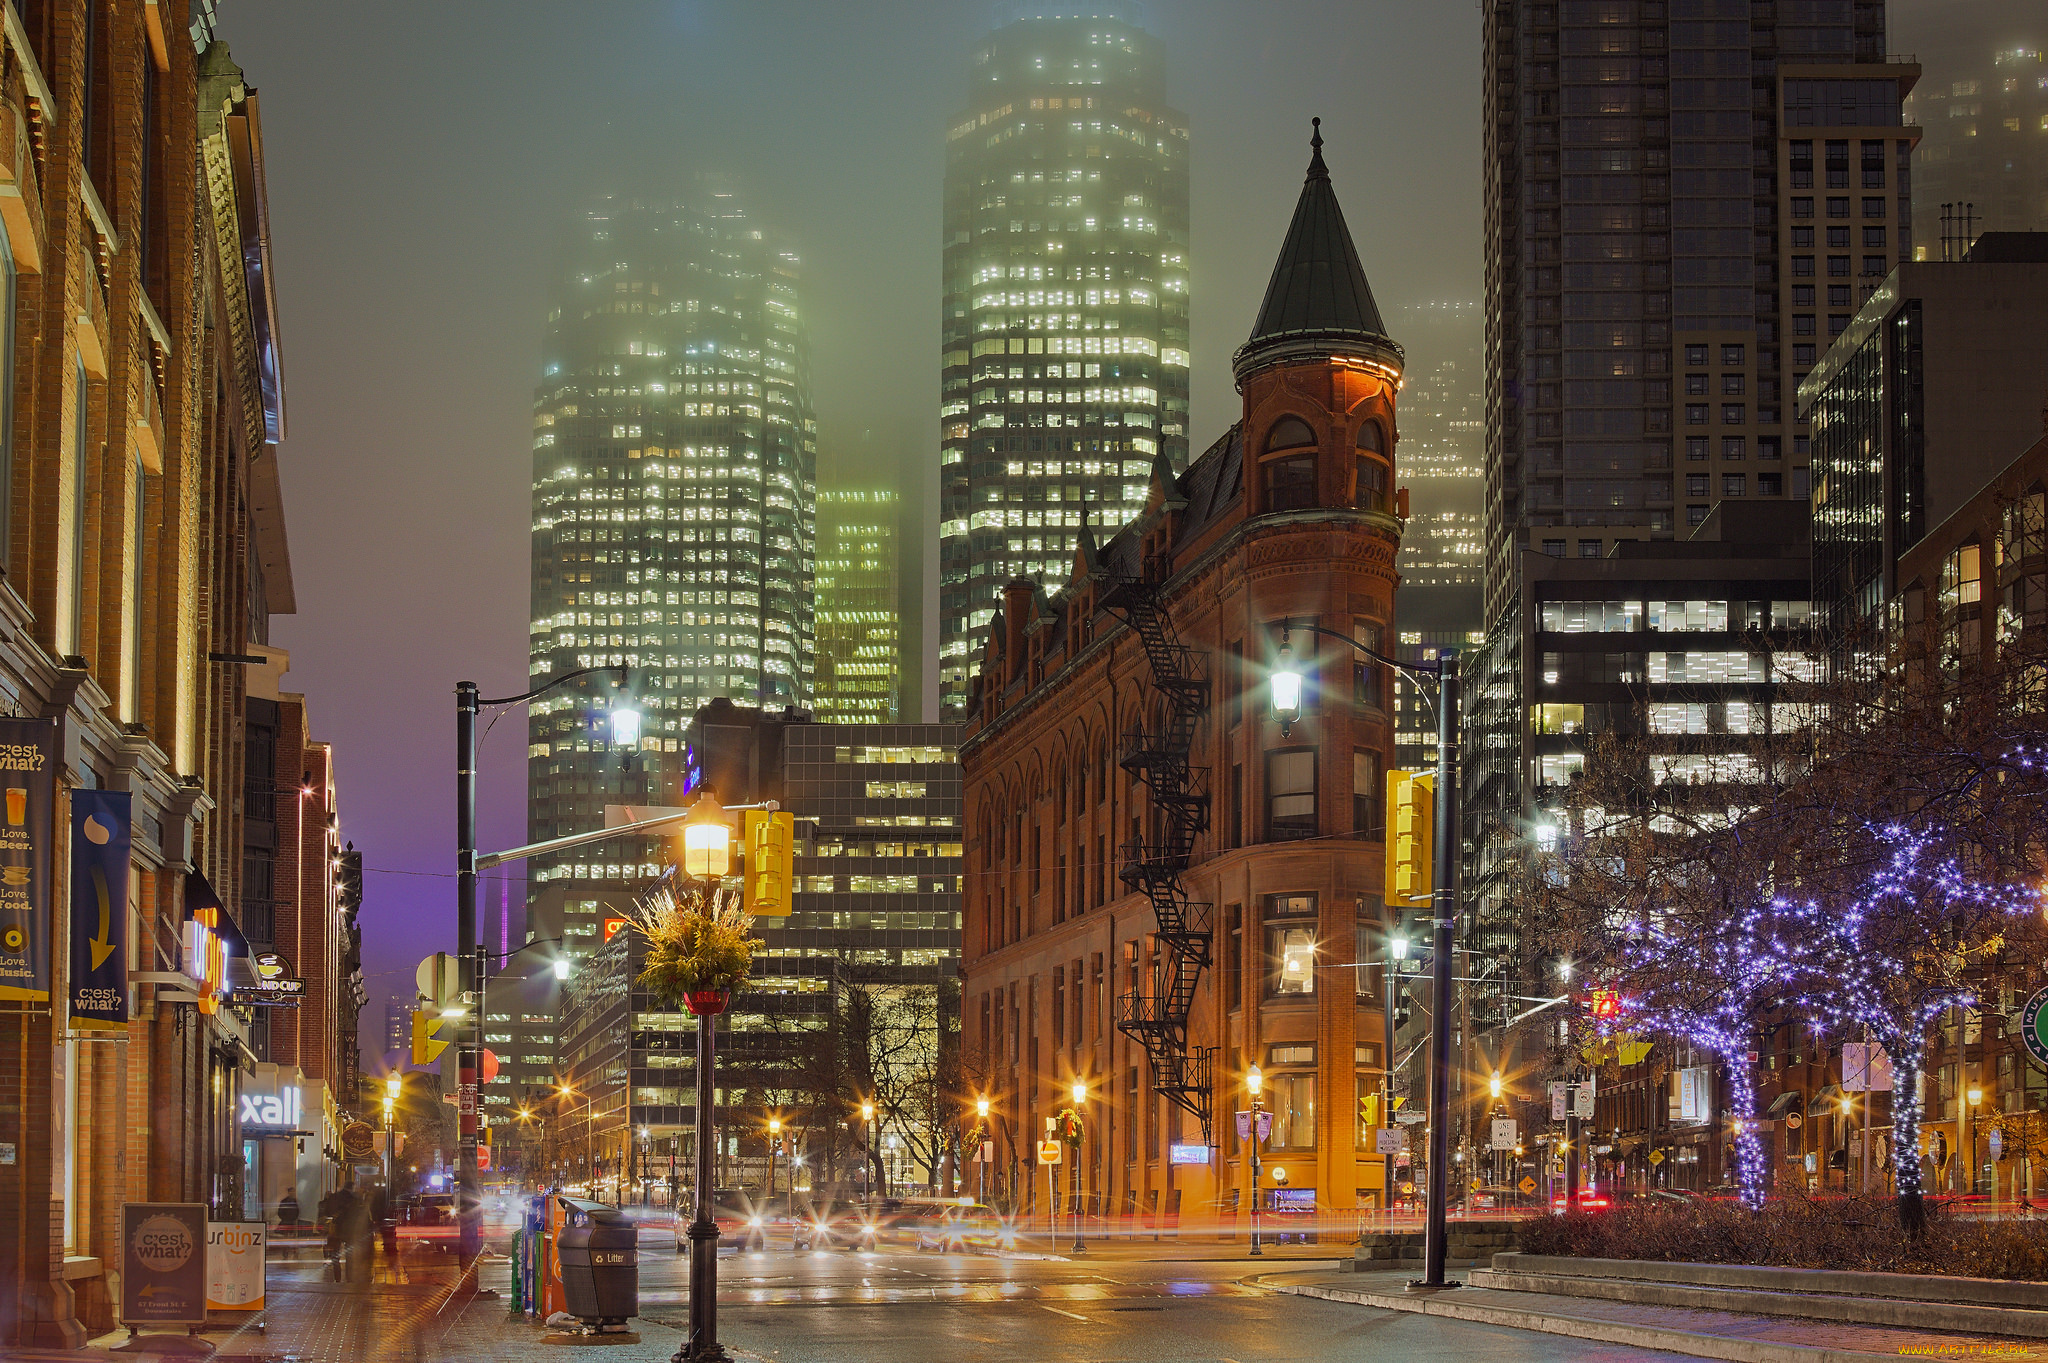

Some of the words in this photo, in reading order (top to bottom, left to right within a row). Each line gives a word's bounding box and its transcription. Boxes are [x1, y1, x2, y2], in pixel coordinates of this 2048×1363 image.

[2, 828, 30, 839] Love.
[0, 839, 33, 850] Beer.
[1, 888, 29, 899] Love.
[0, 955, 28, 966] Love.
[74, 996, 122, 1011] what?
[345, 1035, 356, 1089] WINNERS
[1498, 1122, 1510, 1130] ONE
[1385, 1131, 1395, 1139] NO
[137, 1243, 191, 1258] what?
[607, 1253, 624, 1263] Litter
